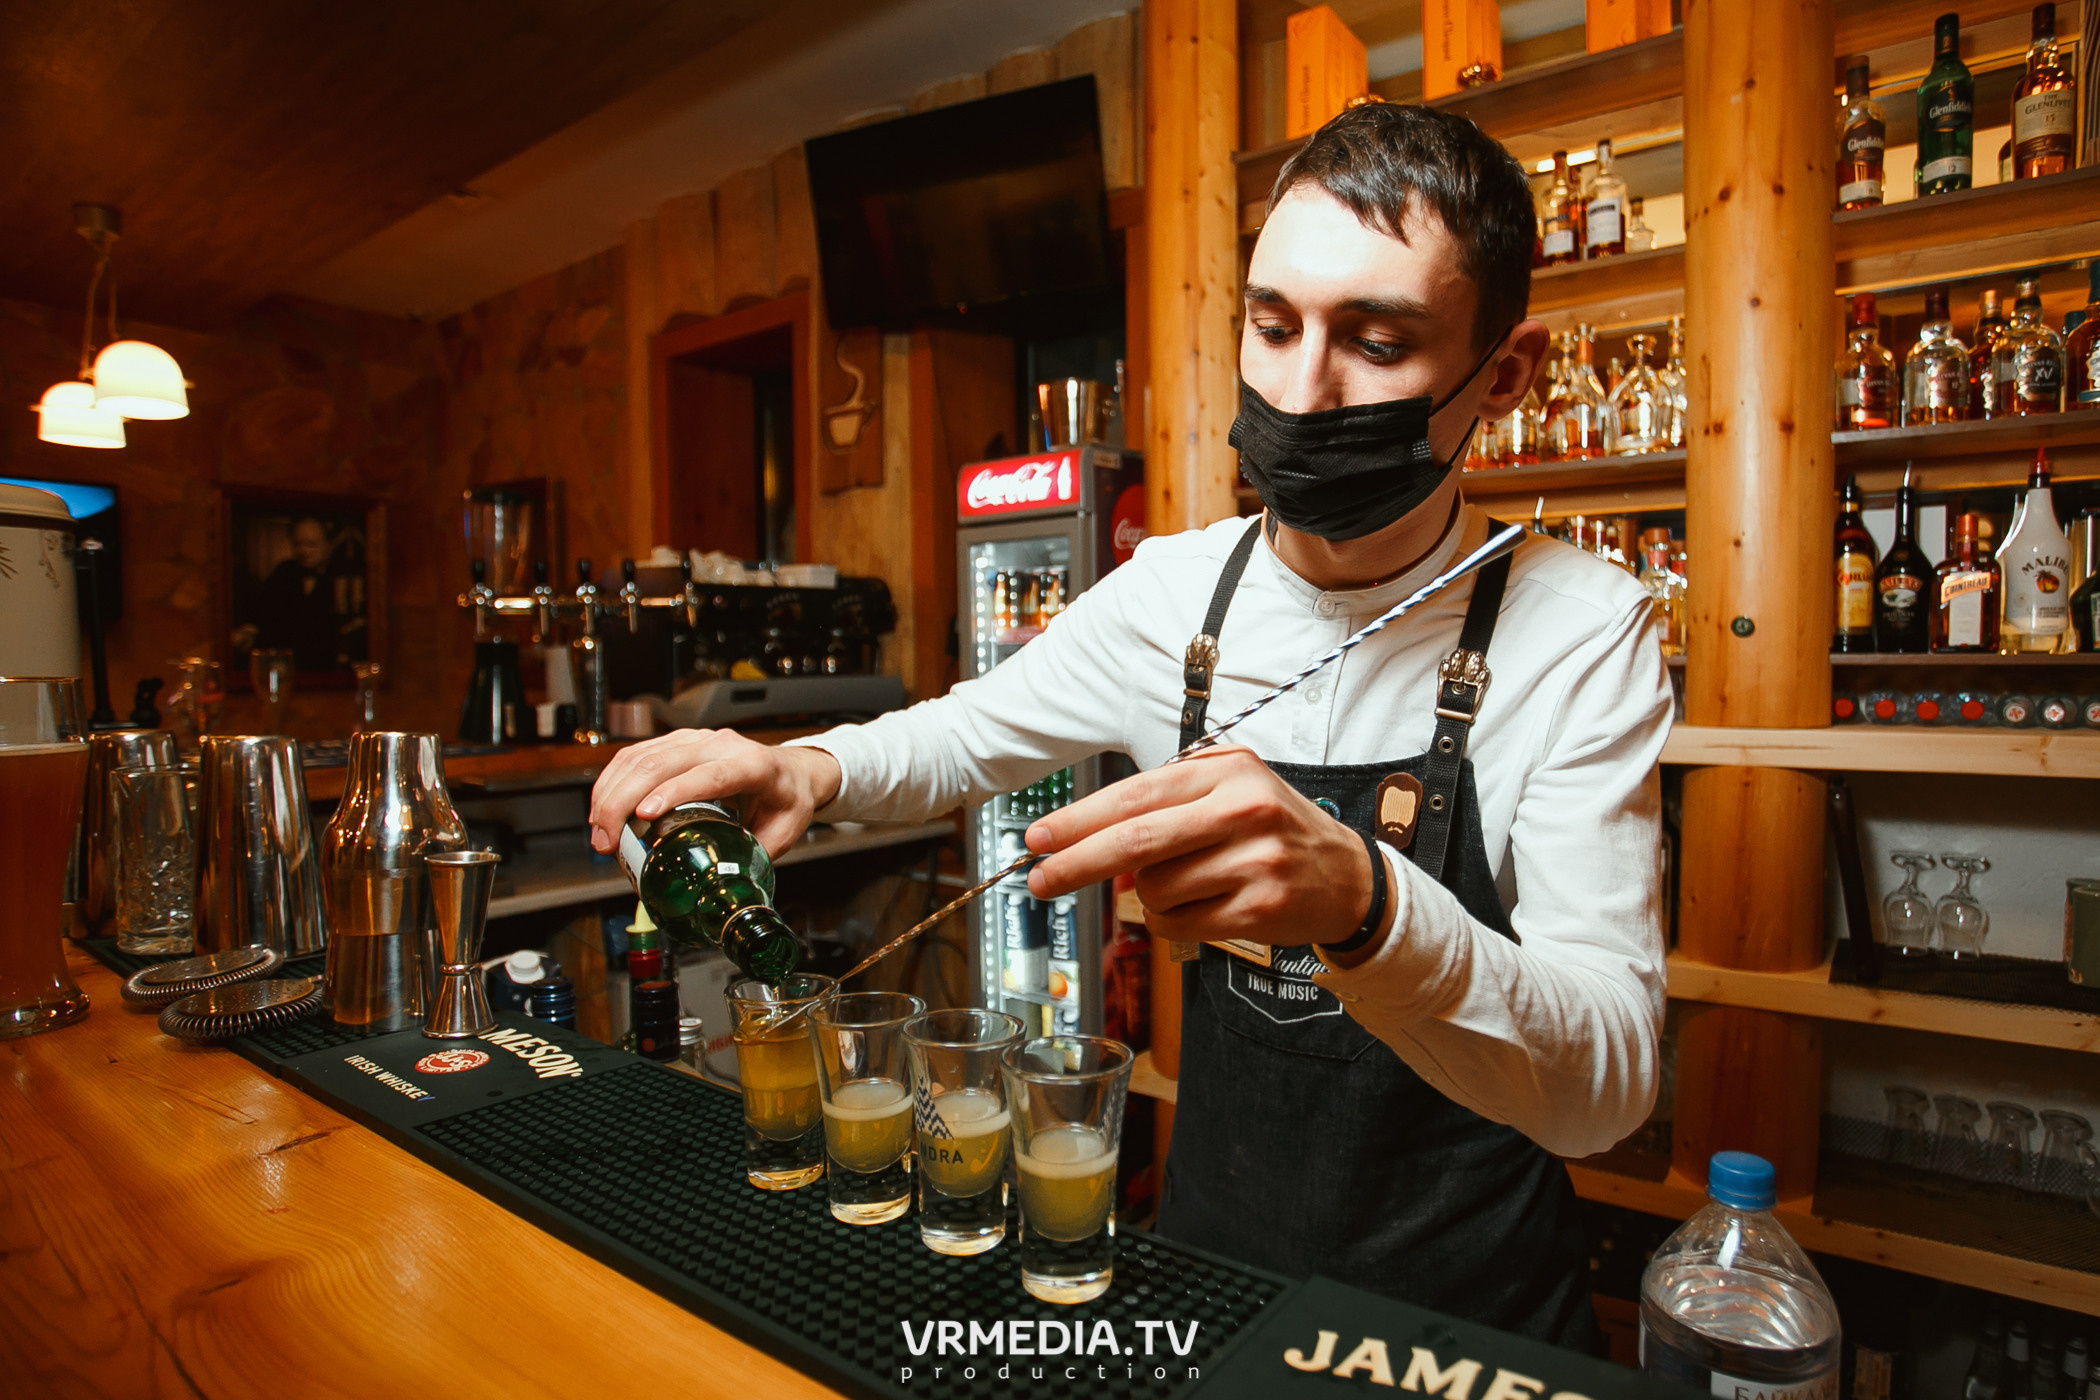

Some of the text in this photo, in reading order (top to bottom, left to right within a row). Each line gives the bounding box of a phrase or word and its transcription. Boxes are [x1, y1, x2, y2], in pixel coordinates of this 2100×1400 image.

[1052, 917, 1071, 960] Rich
[1247, 972, 1318, 1002] TRUE MUSIC
[478, 1028, 584, 1080] MESON
[343, 1054, 436, 1102] IRISH WHISKEY
[920, 1142, 964, 1164] NDRA
